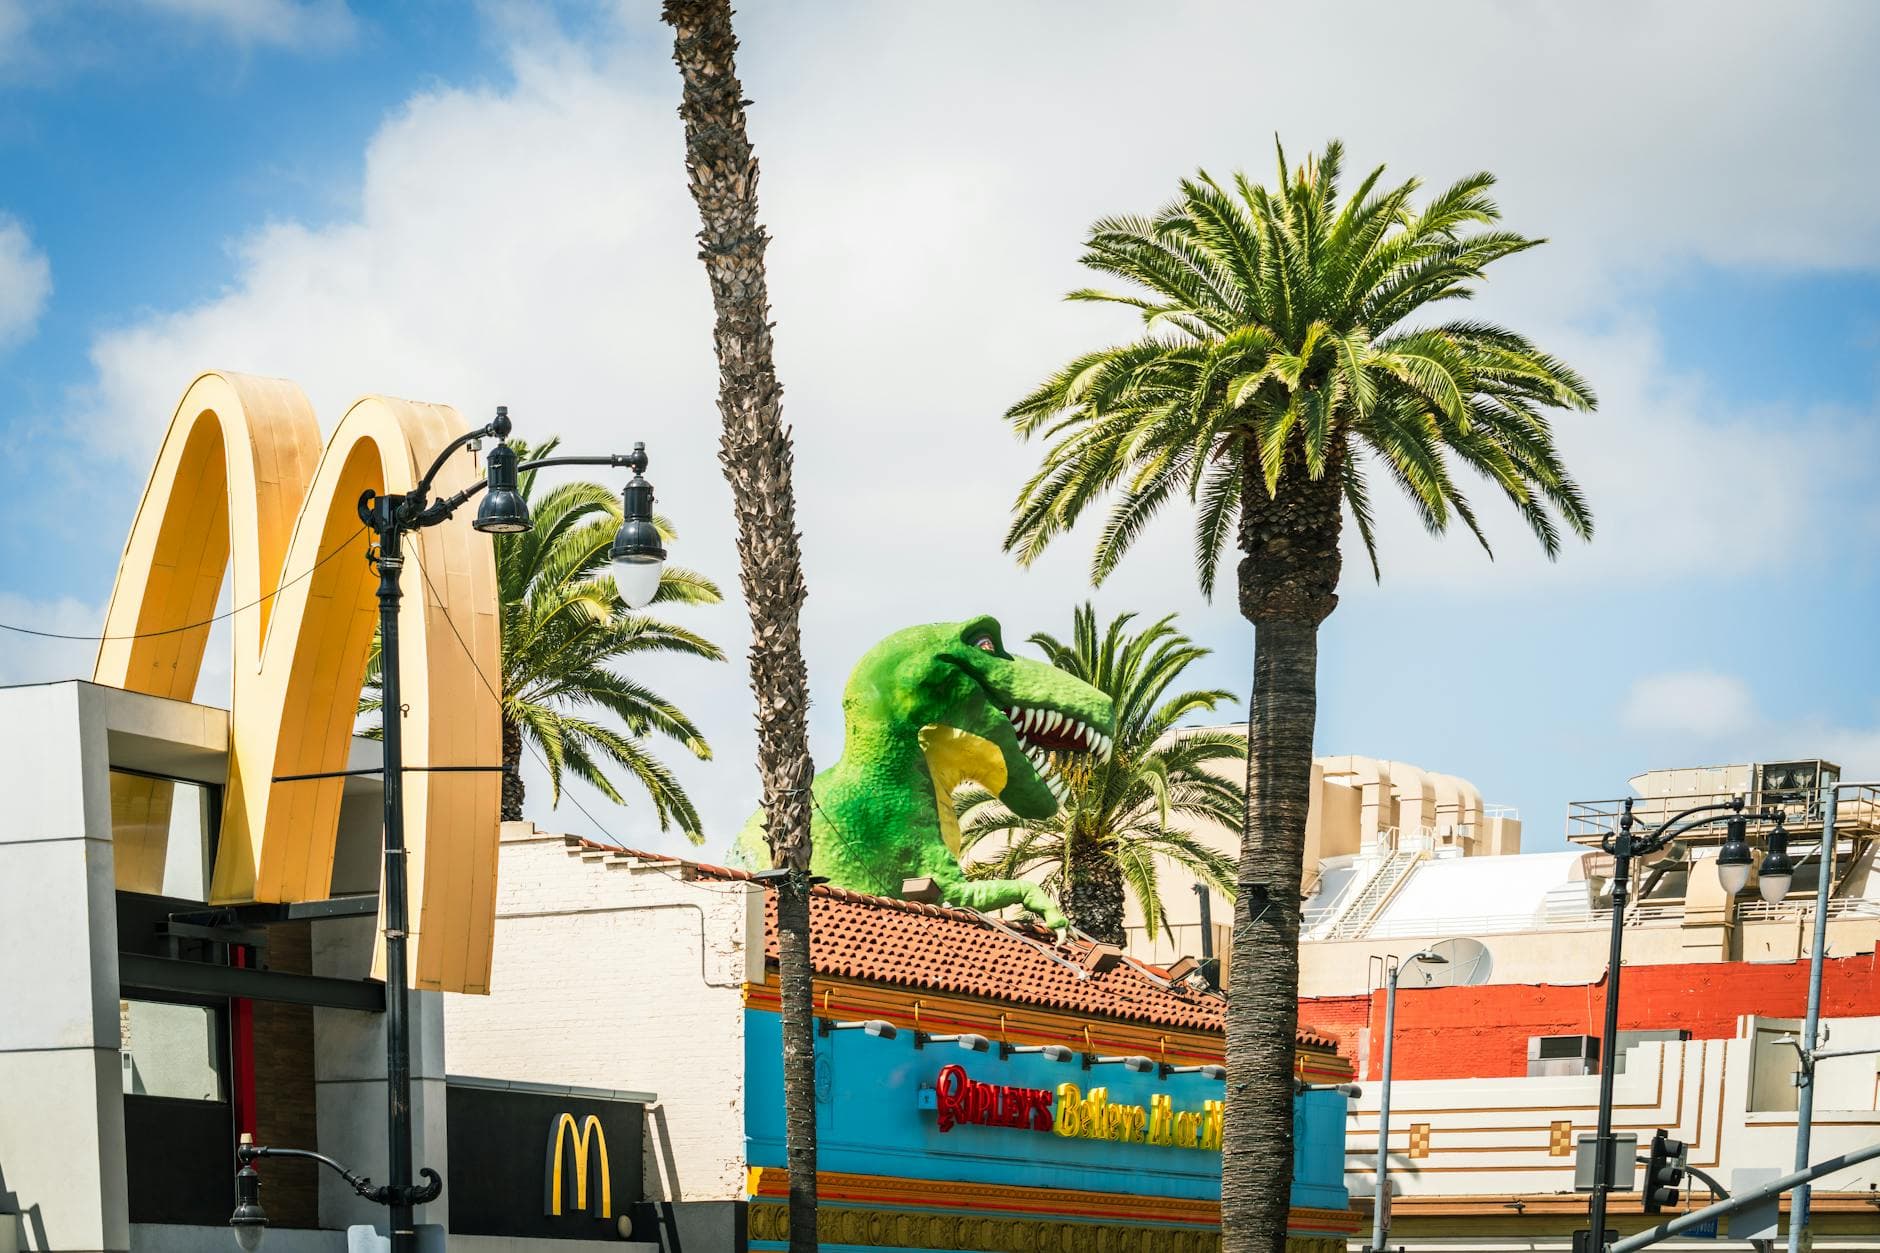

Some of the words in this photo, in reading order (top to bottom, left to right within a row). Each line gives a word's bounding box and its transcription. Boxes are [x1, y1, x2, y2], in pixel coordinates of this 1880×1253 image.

[1054, 1082, 1146, 1145] Believe
[1147, 1093, 1173, 1147] It
[1174, 1110, 1202, 1149] or
[545, 1112, 611, 1218] M
